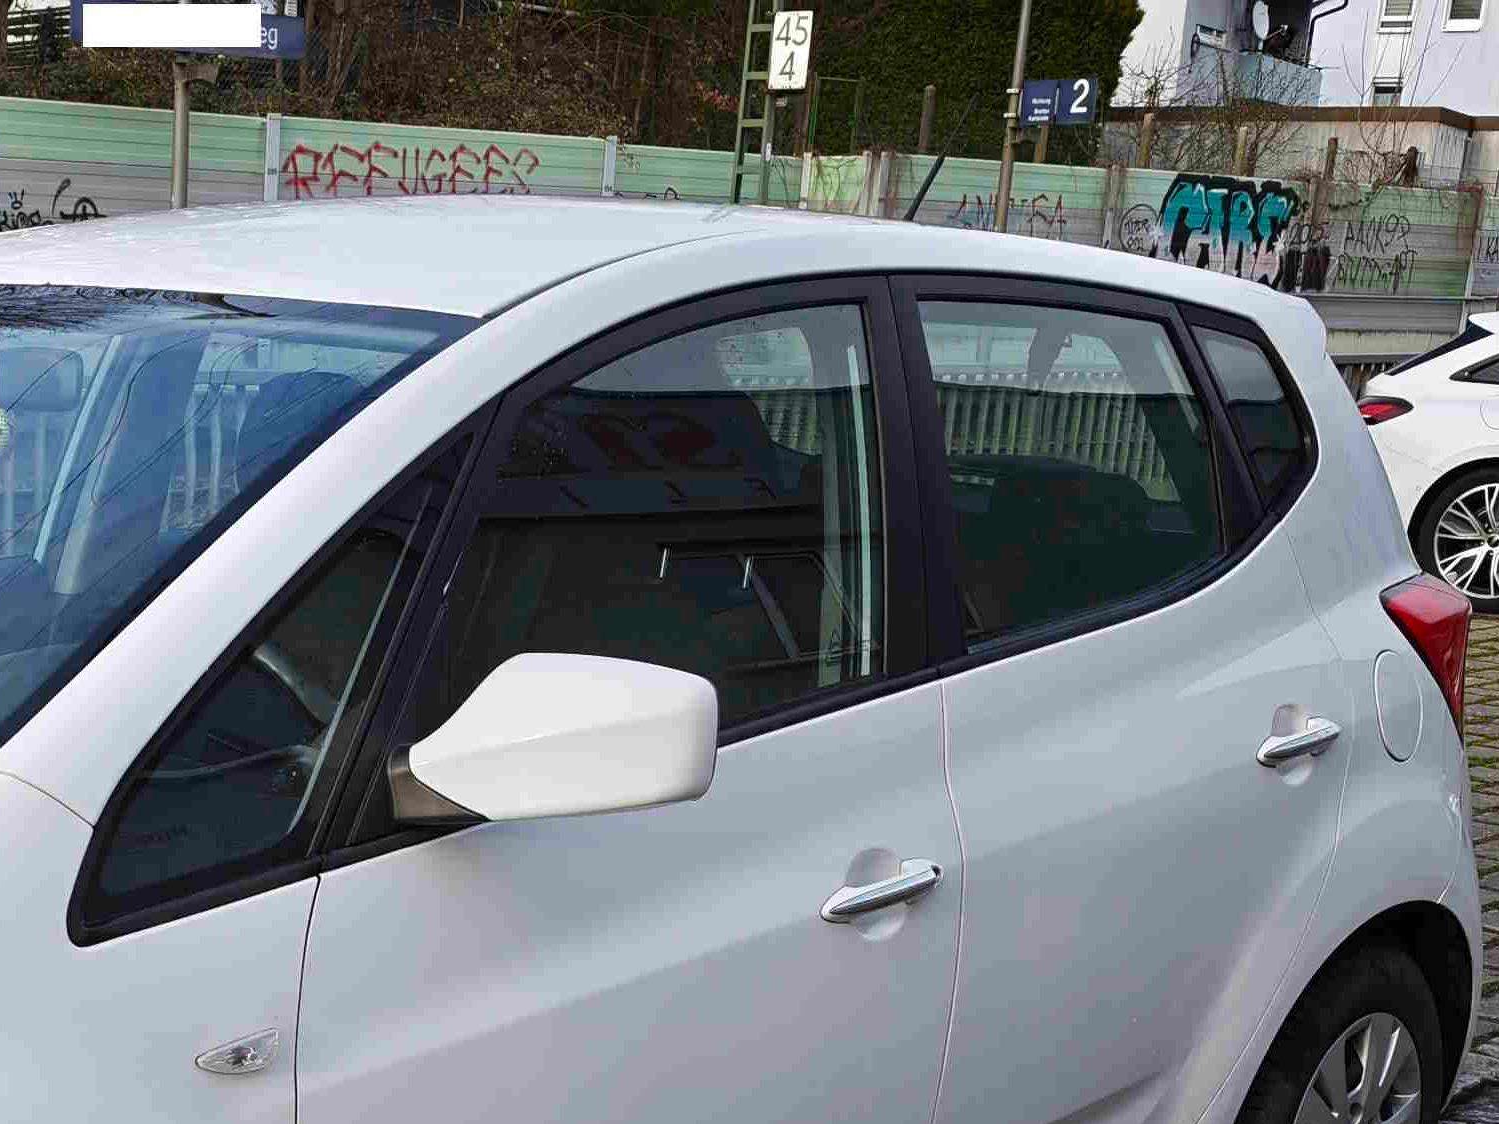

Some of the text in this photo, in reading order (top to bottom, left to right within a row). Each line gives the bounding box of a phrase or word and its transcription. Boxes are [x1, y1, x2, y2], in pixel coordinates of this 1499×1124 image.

[774, 15, 809, 46] 45
[779, 50, 796, 82] 4
[1070, 79, 1090, 114] 2
[282, 141, 540, 200] REFUGEES
